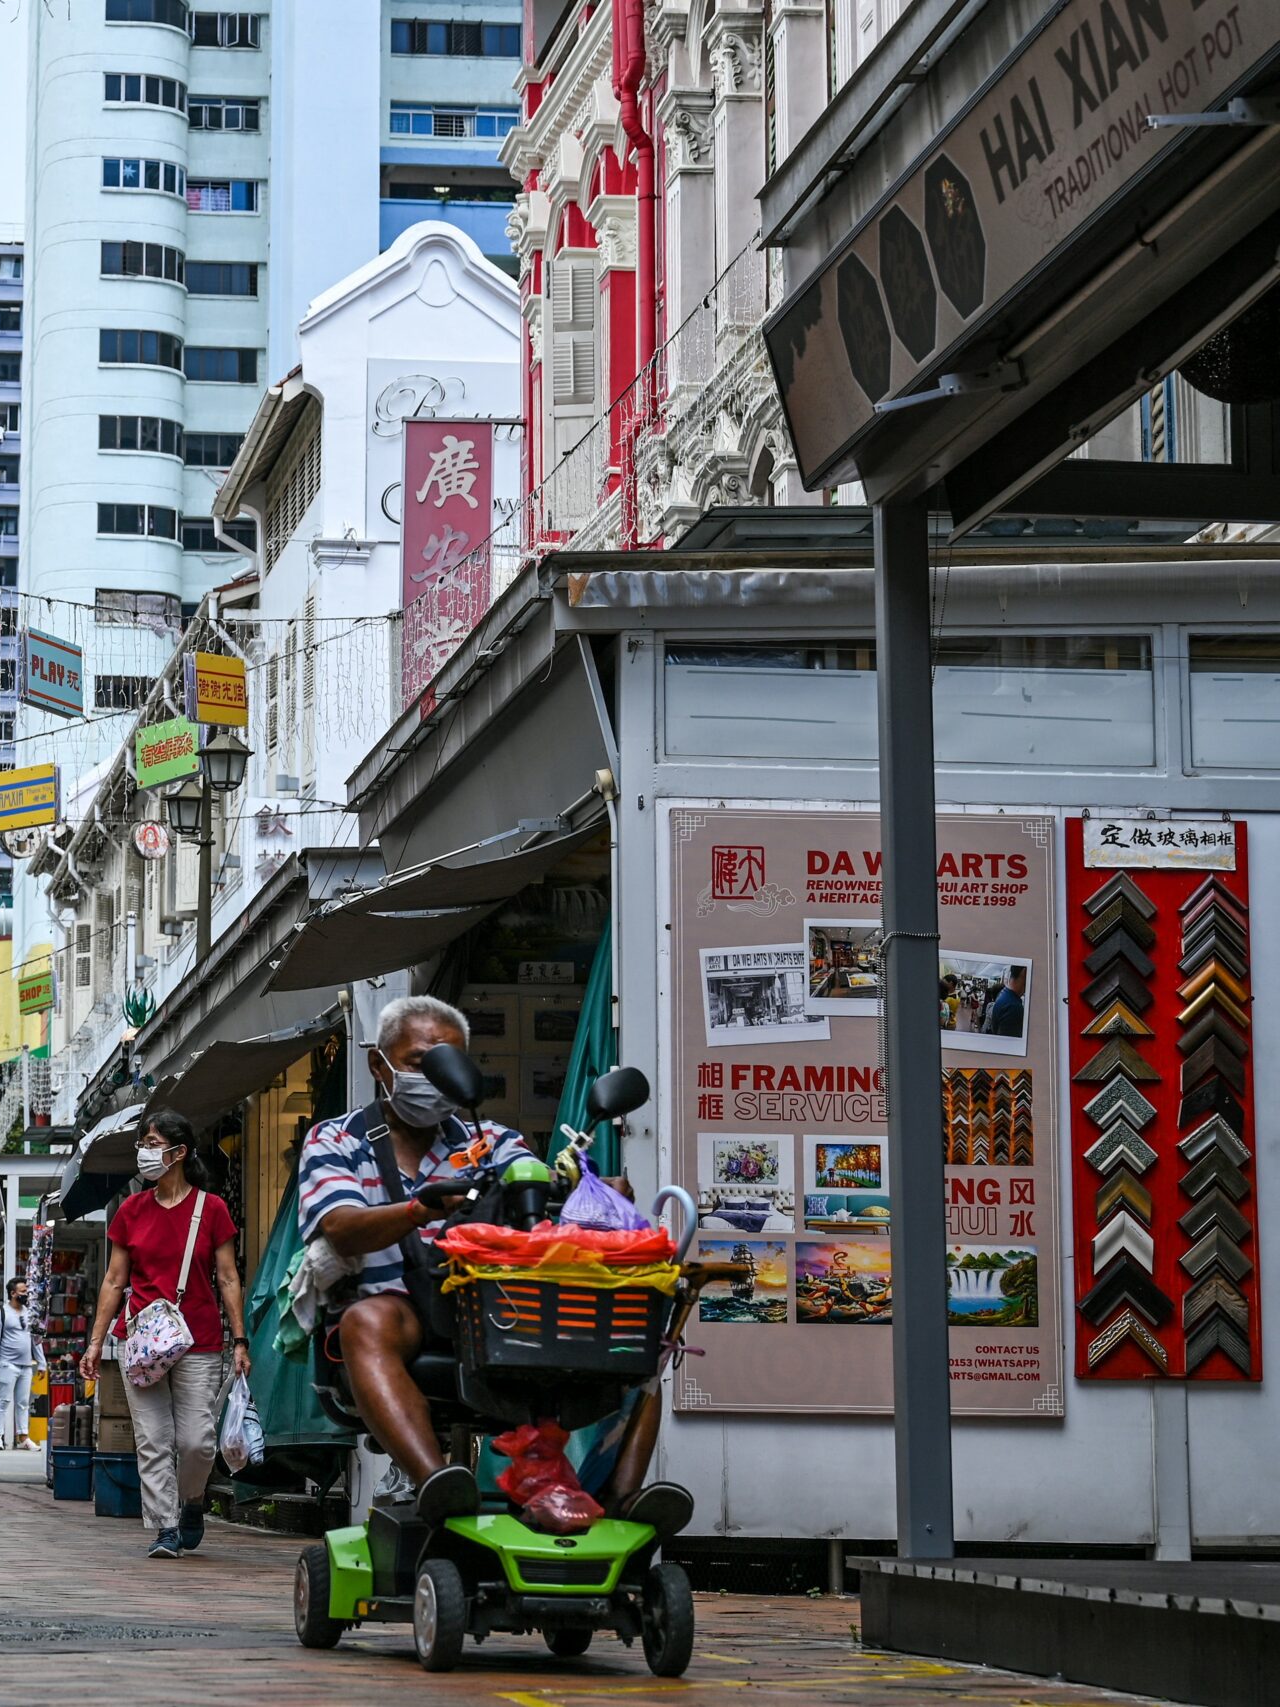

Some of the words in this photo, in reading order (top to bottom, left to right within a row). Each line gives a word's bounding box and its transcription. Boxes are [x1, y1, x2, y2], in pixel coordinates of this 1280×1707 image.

[979, 76, 1055, 205] HAI
[1054, 0, 1169, 130] XIAN
[1044, 93, 1153, 219] TRADITIONAL
[1158, 46, 1199, 113] HOT
[1201, 6, 1243, 74] POT
[31, 654, 65, 687] PLAY
[67, 670, 80, 692] 玩
[198, 678, 245, 702] 谢谢光临
[141, 732, 194, 768] 有空再来
[1100, 824, 1235, 848] 定做玻璃相框
[807, 850, 856, 876] DA
[937, 853, 1028, 879] ARTS
[806, 892, 816, 903] A
[819, 893, 882, 904] HERITAG
[941, 895, 980, 906] SINCE
[983, 896, 1016, 907] 1998
[960, 883, 988, 893] ART
[991, 883, 1028, 894] SHOP
[732, 954, 740, 967] DA
[742, 953, 752, 966] WEI
[753, 953, 767, 966] ARTS
[19, 984, 42, 1002] SHOP
[697, 1062, 723, 1120] 相框
[734, 1092, 888, 1122] SERVICE
[1009, 1178, 1036, 1237] 风水
[975, 1345, 1024, 1354] CONTACT
[1026, 1346, 1040, 1355] US
[974, 1359, 1040, 1369] (WHATSAPP)
